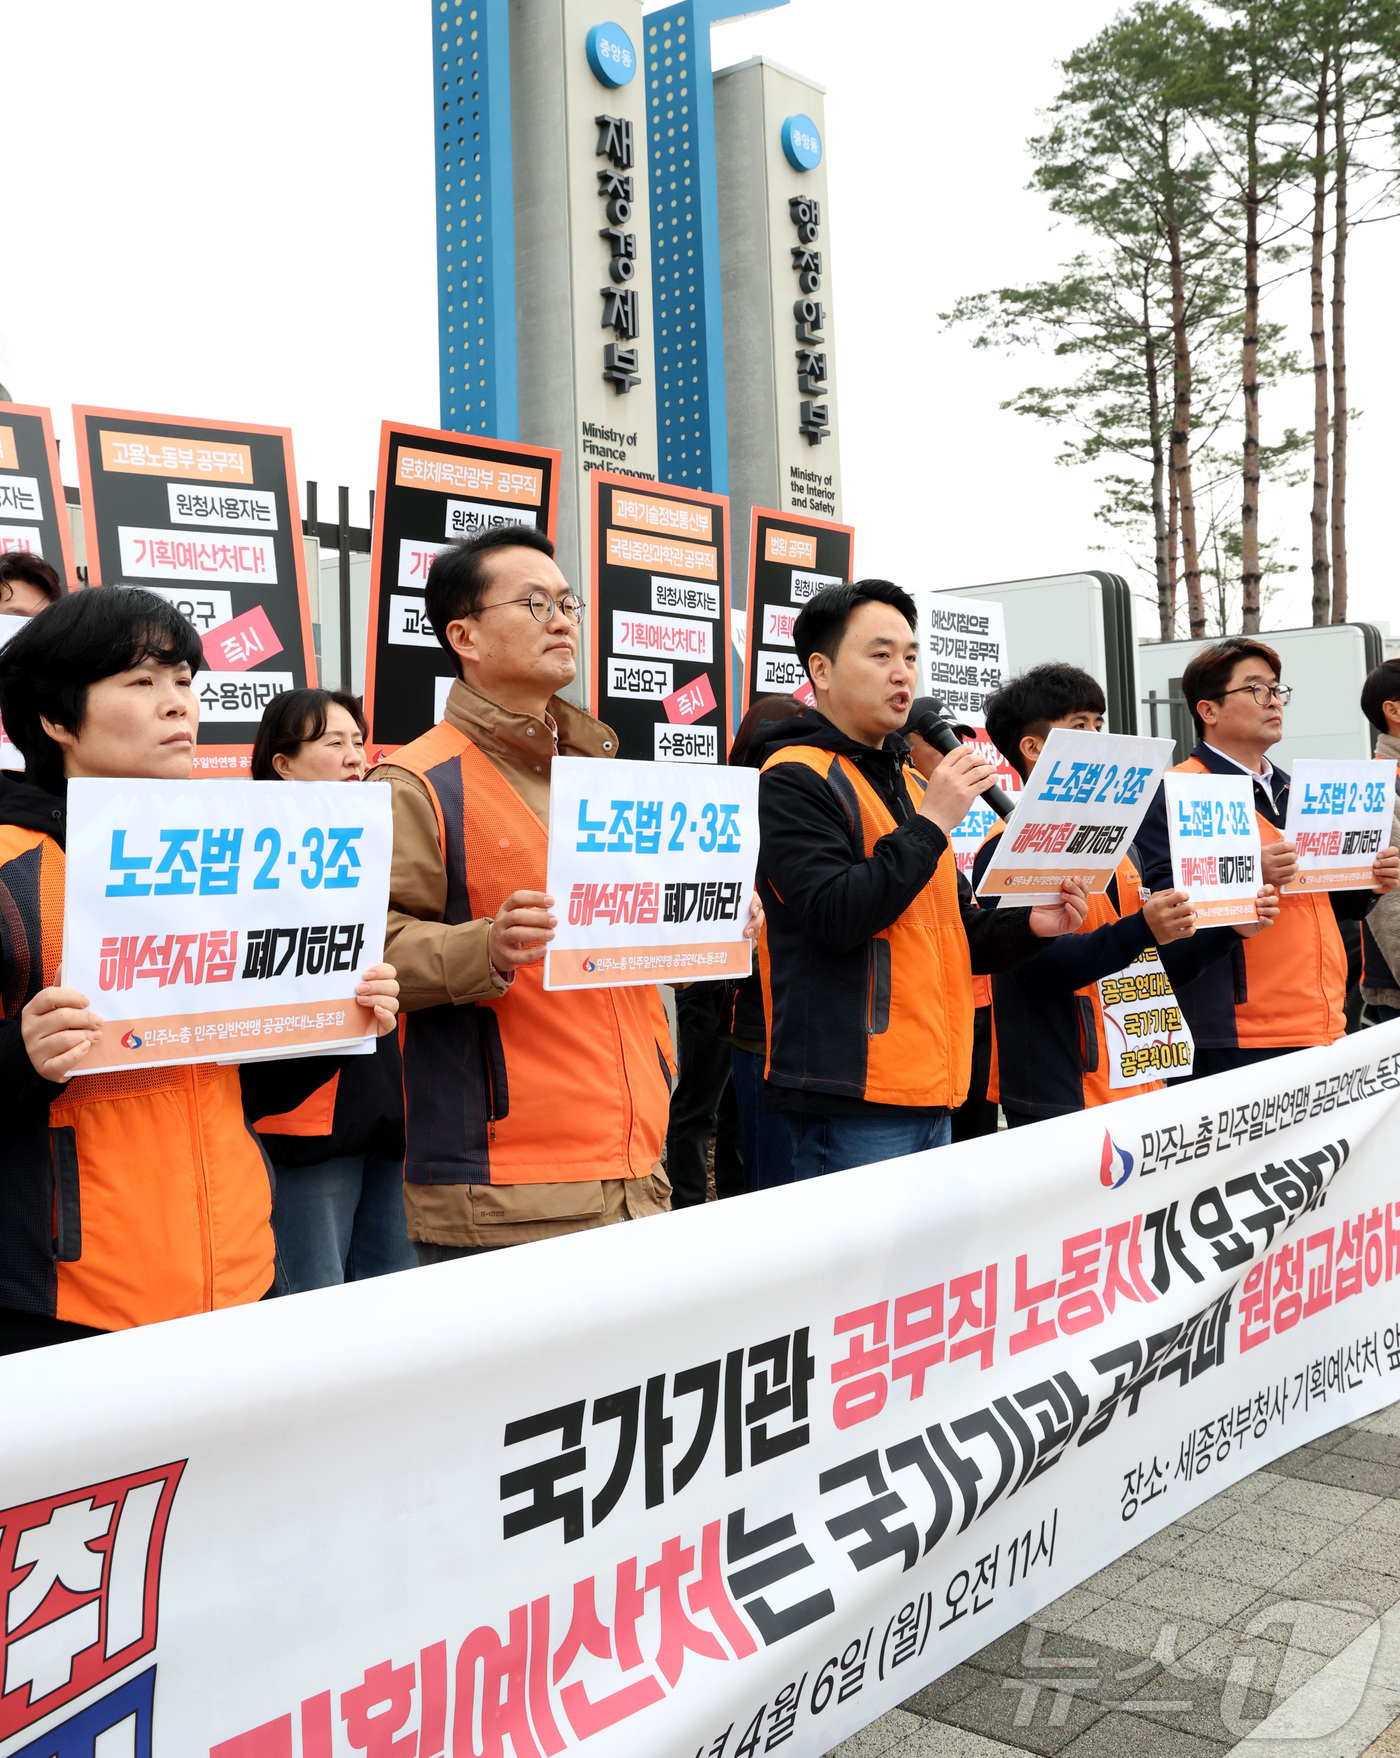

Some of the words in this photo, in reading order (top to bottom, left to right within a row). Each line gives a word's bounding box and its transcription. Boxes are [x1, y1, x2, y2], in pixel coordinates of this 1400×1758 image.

[600, 38, 632, 68] 중앙동
[793, 129, 819, 154] 중앙동
[594, 114, 641, 395] 재정경제부
[789, 194, 831, 447] 행정안전부
[582, 421, 625, 446] Ministry
[627, 432, 638, 447] of
[583, 439, 626, 461] Finance
[112, 442, 194, 470] 고용노동부
[197, 449, 244, 475] 공무직
[401, 456, 494, 491] 문화체육관광부
[497, 471, 537, 497] 공무직
[790, 465, 822, 486] Ministry
[824, 475, 832, 486] of
[790, 480, 804, 494] the
[806, 483, 835, 500] Interior
[176, 494, 271, 521] 원청사용자는
[616, 499, 709, 533] 과학기술정보통신부
[791, 497, 807, 508] and
[809, 498, 835, 516] Safety
[133, 539, 266, 574] 기획예산처다!
[610, 537, 684, 567] 국립중앙과학관
[684, 549, 714, 572] 공무직
[770, 536, 787, 556] 법원
[789, 539, 812, 560] 공무직
[656, 585, 716, 611] 원청사용자는
[621, 622, 706, 655] 기획예산처다!
[931, 609, 989, 636] 예산지침으로
[220, 626, 264, 663] 즉시
[930, 634, 968, 659] 국가기관
[968, 640, 999, 663] 공무직
[613, 667, 668, 694] 교섭요구
[980, 668, 1001, 688] 수당
[677, 685, 704, 716] 즉시
[658, 732, 714, 757] 수용하라!
[1038, 760, 1106, 803] 노조법
[1301, 783, 1347, 815] 노조법
[576, 799, 663, 854] 노조법
[1179, 800, 1213, 837] 노조법
[1011, 823, 1077, 854] 해석지침
[1065, 825, 1128, 855] 폐기하라
[1295, 831, 1343, 857] 해석지침
[1341, 829, 1382, 855] 폐기하라
[104, 827, 244, 898] 노조법
[1181, 856, 1218, 887] 해석지침
[1218, 855, 1255, 884] 폐기하라
[568, 882, 660, 926] 해석지침
[663, 882, 742, 924] 폐기하라
[98, 930, 239, 992] 해석지침
[242, 923, 365, 980] 폐기하라
[597, 957, 628, 972] 민주노총
[628, 955, 672, 970] 민주일반연맹
[673, 951, 728, 968] 공공연대노동조합
[144, 1026, 192, 1047] 민주노총
[194, 1018, 262, 1042] 민주일반연맹
[262, 1010, 346, 1034] 공공연대노동조합
[1124, 1006, 1183, 1037] 국가기관
[1120, 1041, 1191, 1078] 공무직이다
[1140, 1115, 1213, 1177] 민주노총
[1216, 1084, 1311, 1153] 민주일반연맹
[500, 1325, 815, 1545] 국가기관
[831, 1262, 998, 1430] 공무직
[1009, 1200, 1205, 1356] 노동자가
[819, 1370, 1090, 1573] 국가기관
[1239, 1201, 1400, 1354] 원청교섭하
[1121, 1456, 1170, 1521] 장소:
[1174, 1377, 1289, 1481] 세종정부청사
[1292, 1331, 1382, 1412] 기획예산처
[810, 1626, 874, 1706] 6일
[879, 1591, 932, 1682] (월)
[938, 1544, 1000, 1632] 오전
[1008, 1508, 1058, 1588] 11시
